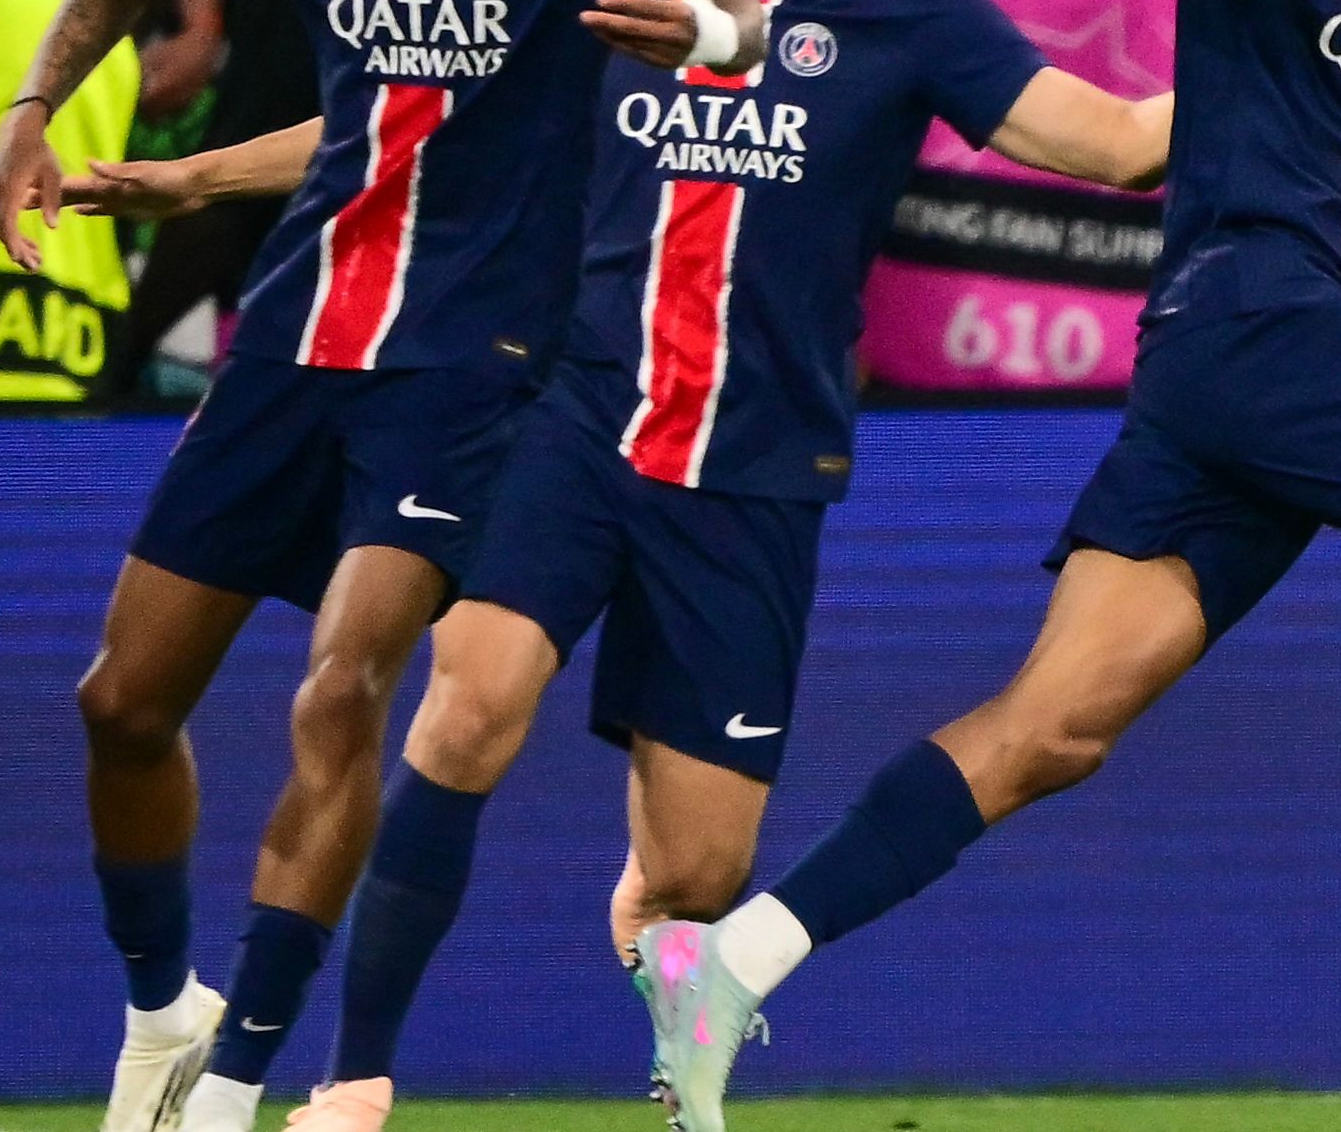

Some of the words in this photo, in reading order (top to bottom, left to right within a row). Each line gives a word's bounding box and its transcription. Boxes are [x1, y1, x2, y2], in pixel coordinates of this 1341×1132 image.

[364, 45, 508, 78] AIRWAYS
[617, 92, 808, 151] QATAR
[656, 142, 804, 183] AIRWAYS
[944, 295, 1104, 380] 610
